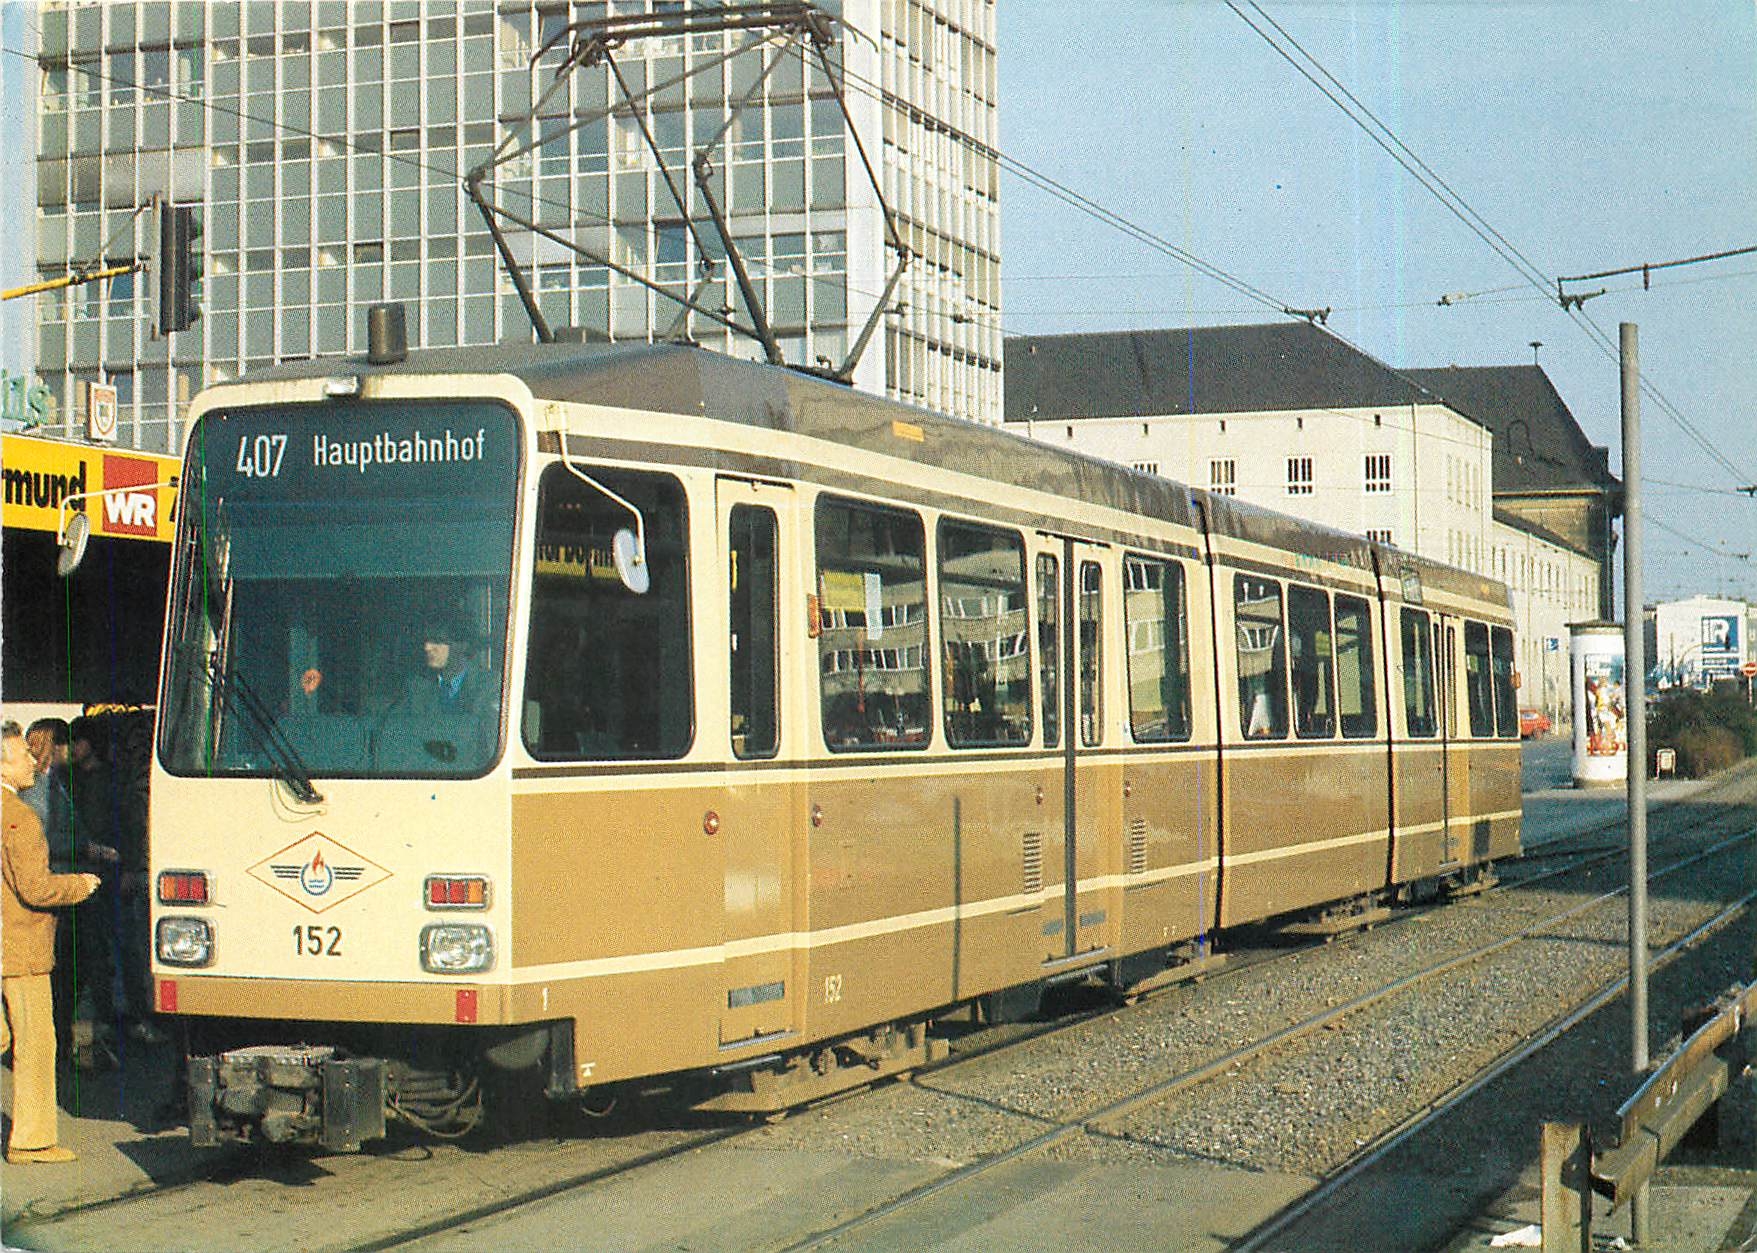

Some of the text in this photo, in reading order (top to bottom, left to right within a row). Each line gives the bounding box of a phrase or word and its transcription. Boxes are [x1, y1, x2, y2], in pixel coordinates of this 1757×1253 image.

[236, 429, 485, 477] 407 Hauptbahnhof
[2, 462, 86, 511] mund
[104, 491, 155, 527] WR
[293, 925, 342, 956] 152
[825, 974, 842, 1003] 152
